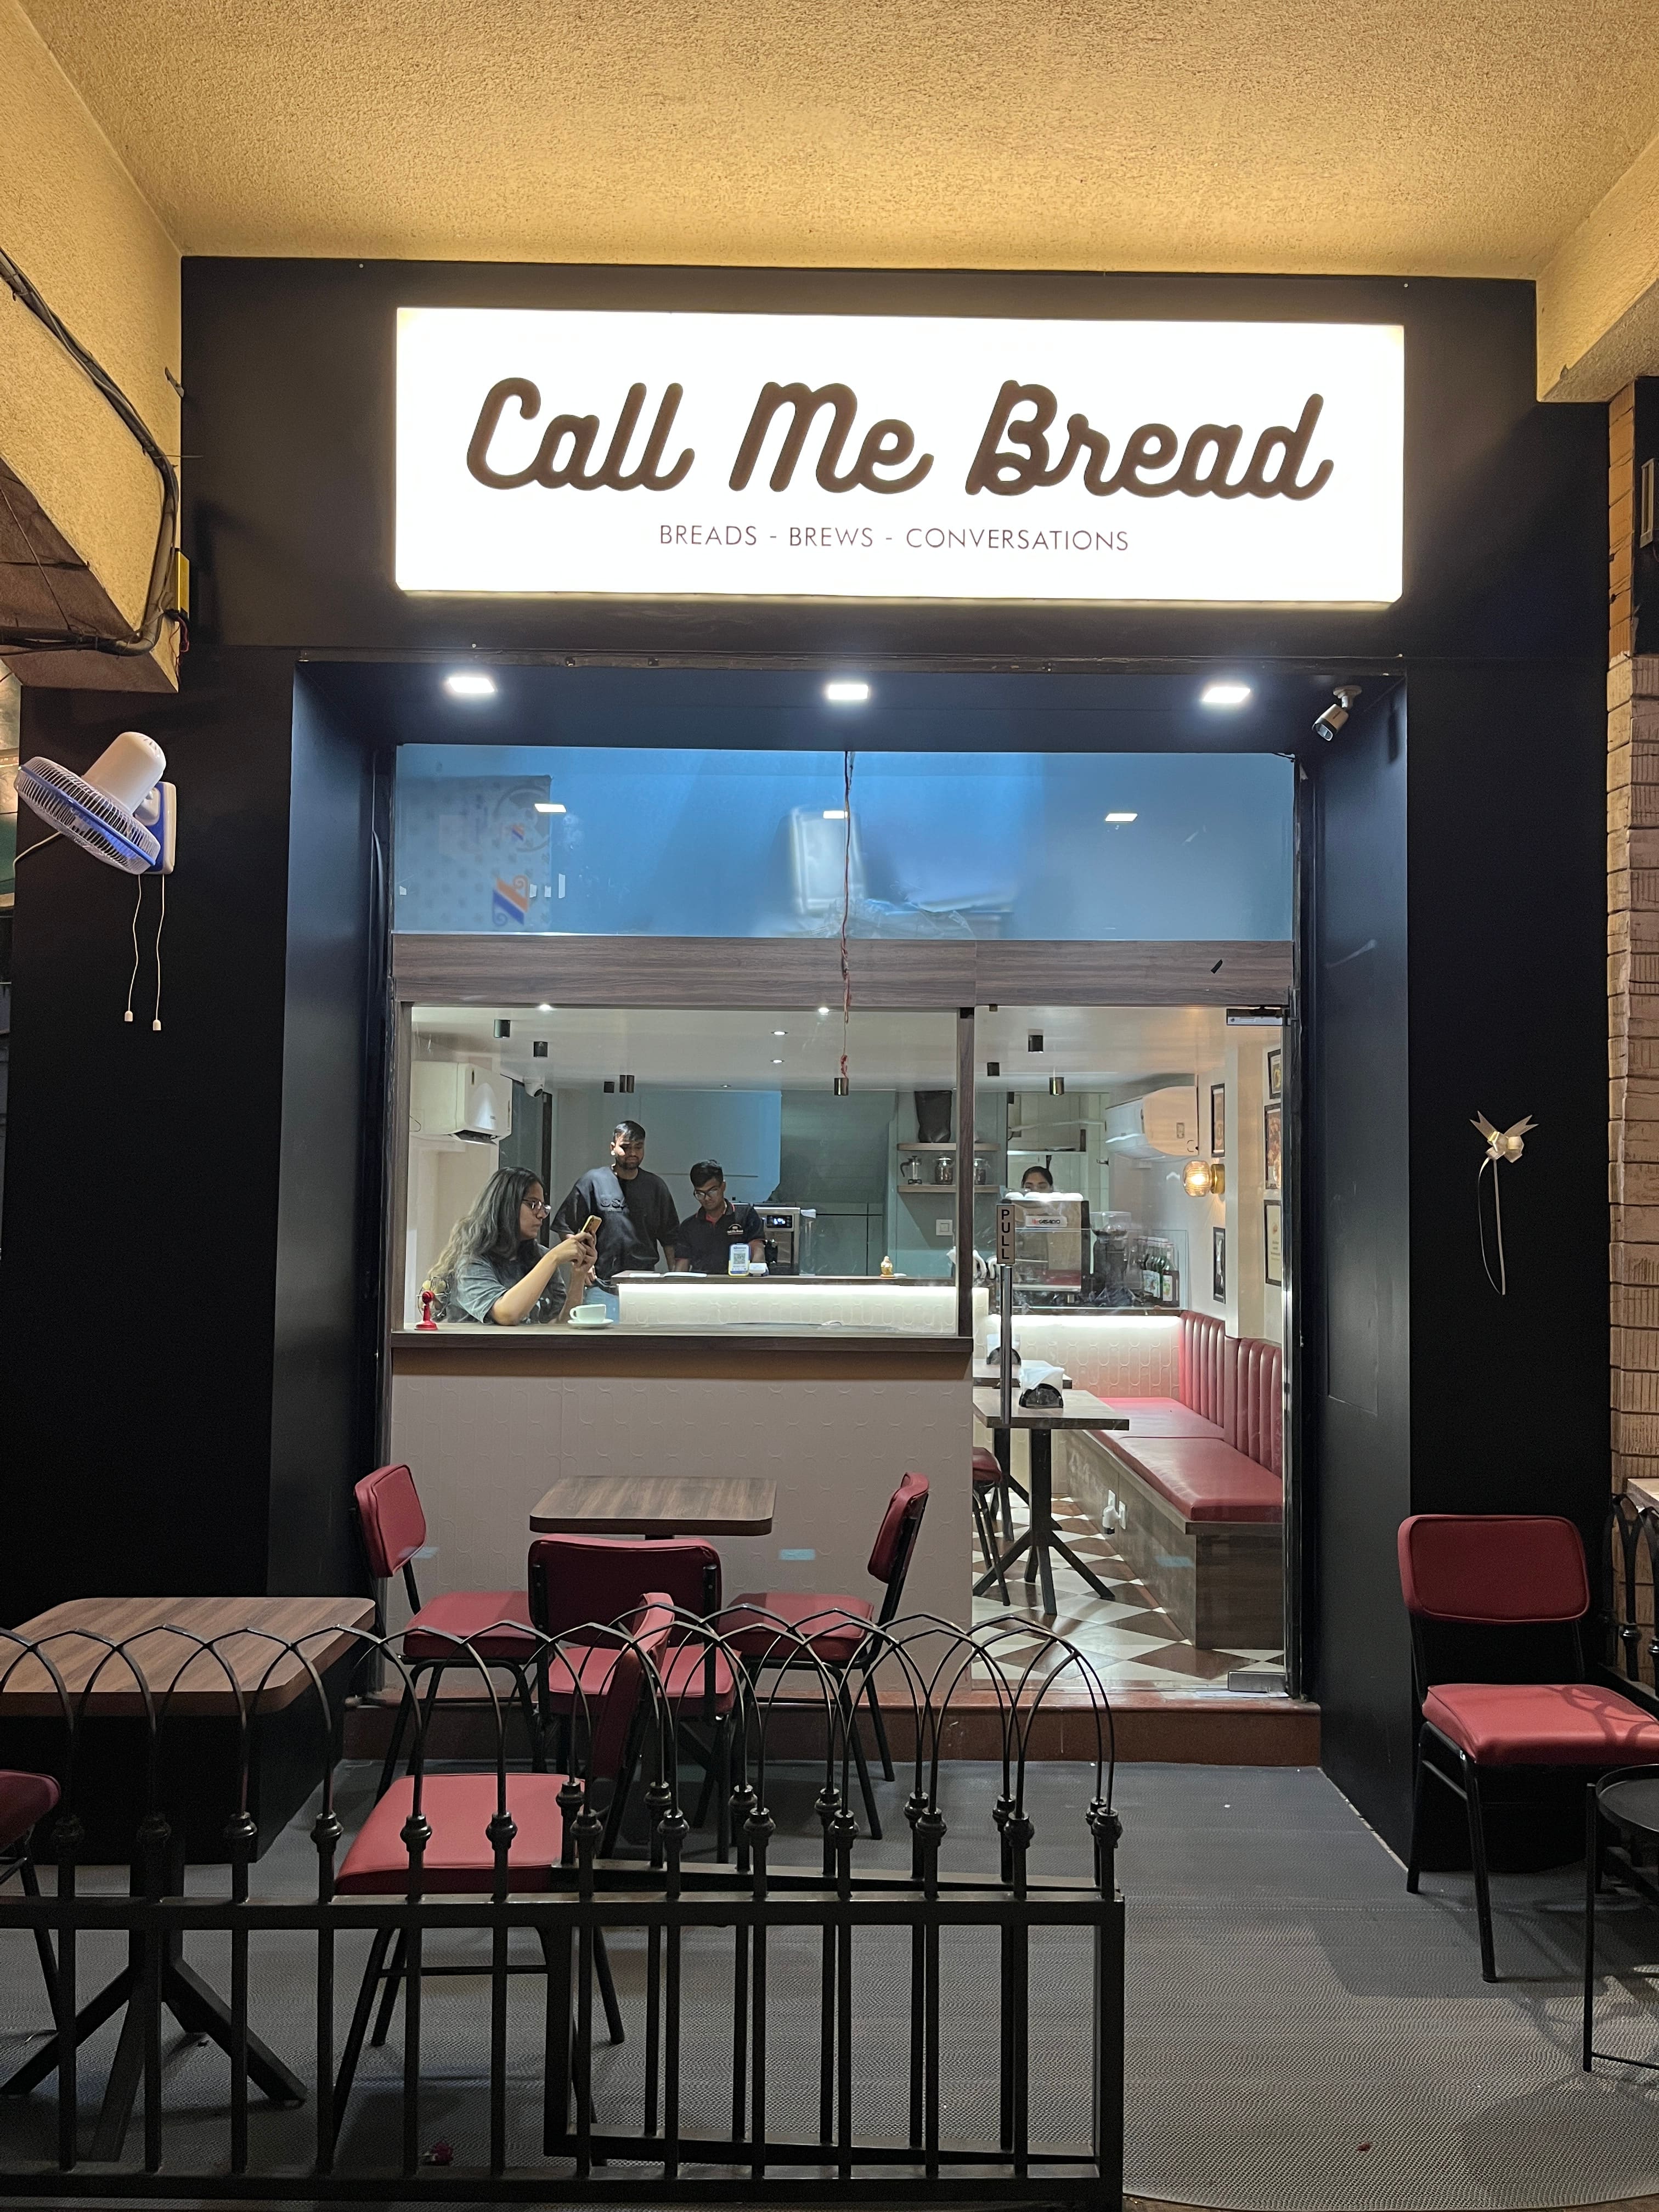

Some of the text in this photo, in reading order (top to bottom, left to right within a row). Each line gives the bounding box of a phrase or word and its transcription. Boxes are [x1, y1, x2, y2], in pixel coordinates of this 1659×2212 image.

[466, 377, 1334, 501] Call Me Bread
[661, 524, 757, 545] BREADS
[789, 527, 873, 548] BREWS
[906, 528, 1128, 551] CONVERSATIONS
[1001, 1209, 1010, 1260] PULL
